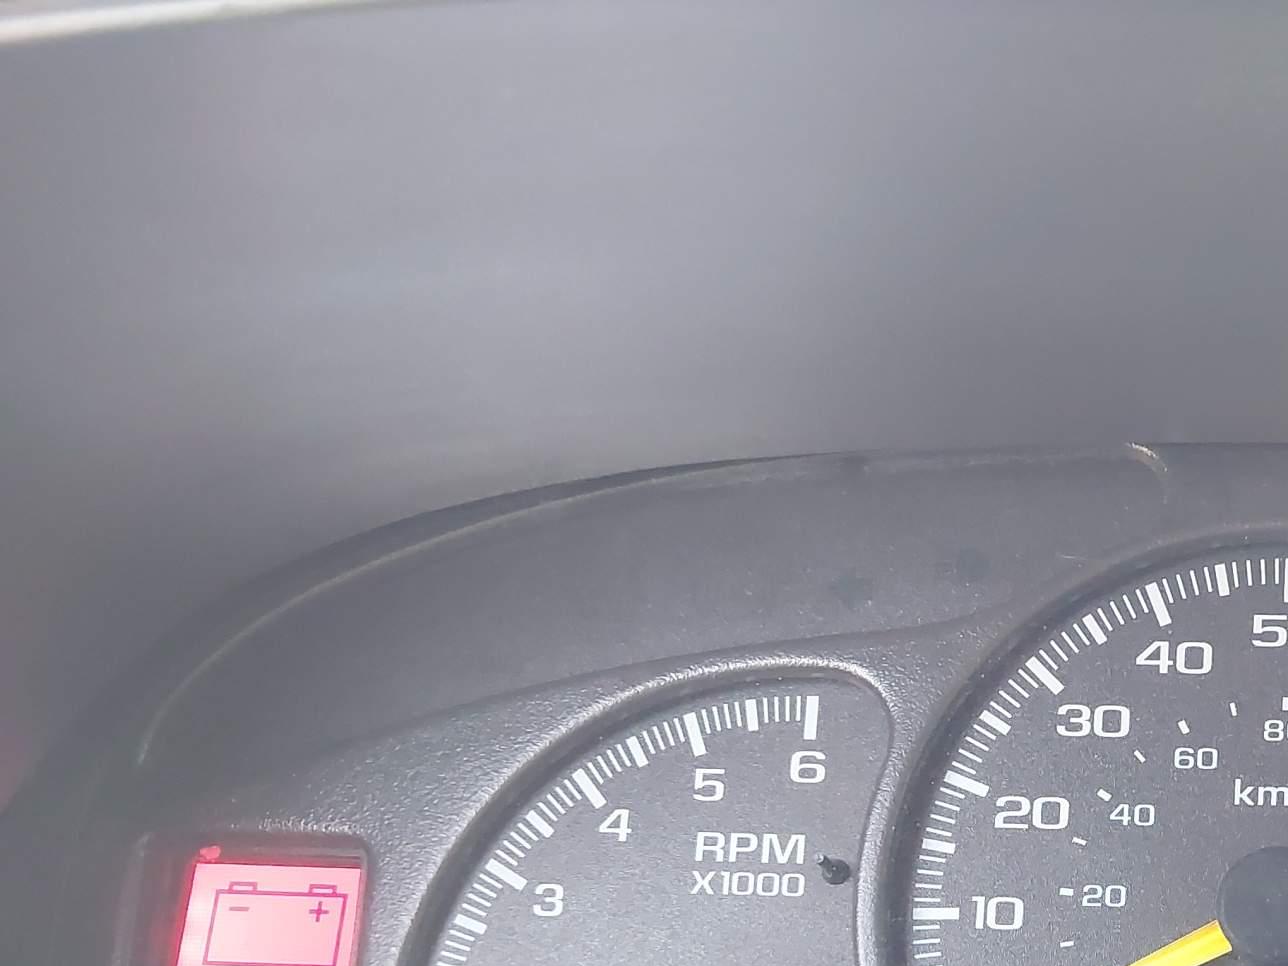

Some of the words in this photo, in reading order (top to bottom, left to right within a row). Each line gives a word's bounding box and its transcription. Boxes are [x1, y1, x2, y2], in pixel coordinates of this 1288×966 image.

[1136, 640, 1213, 675] 40
[1057, 705, 1130, 738] 30
[790, 751, 825, 783] 6
[1174, 747, 1218, 771] 60
[694, 769, 725, 801] 5
[599, 809, 631, 841] 4
[994, 796, 1069, 831] 20
[1110, 803, 1155, 827] 40
[695, 832, 806, 865] RPM
[534, 884, 563, 916] 3
[691, 872, 805, 897] X1000
[1081, 884, 1128, 908] 20
[972, 896, 1024, 931] 10
